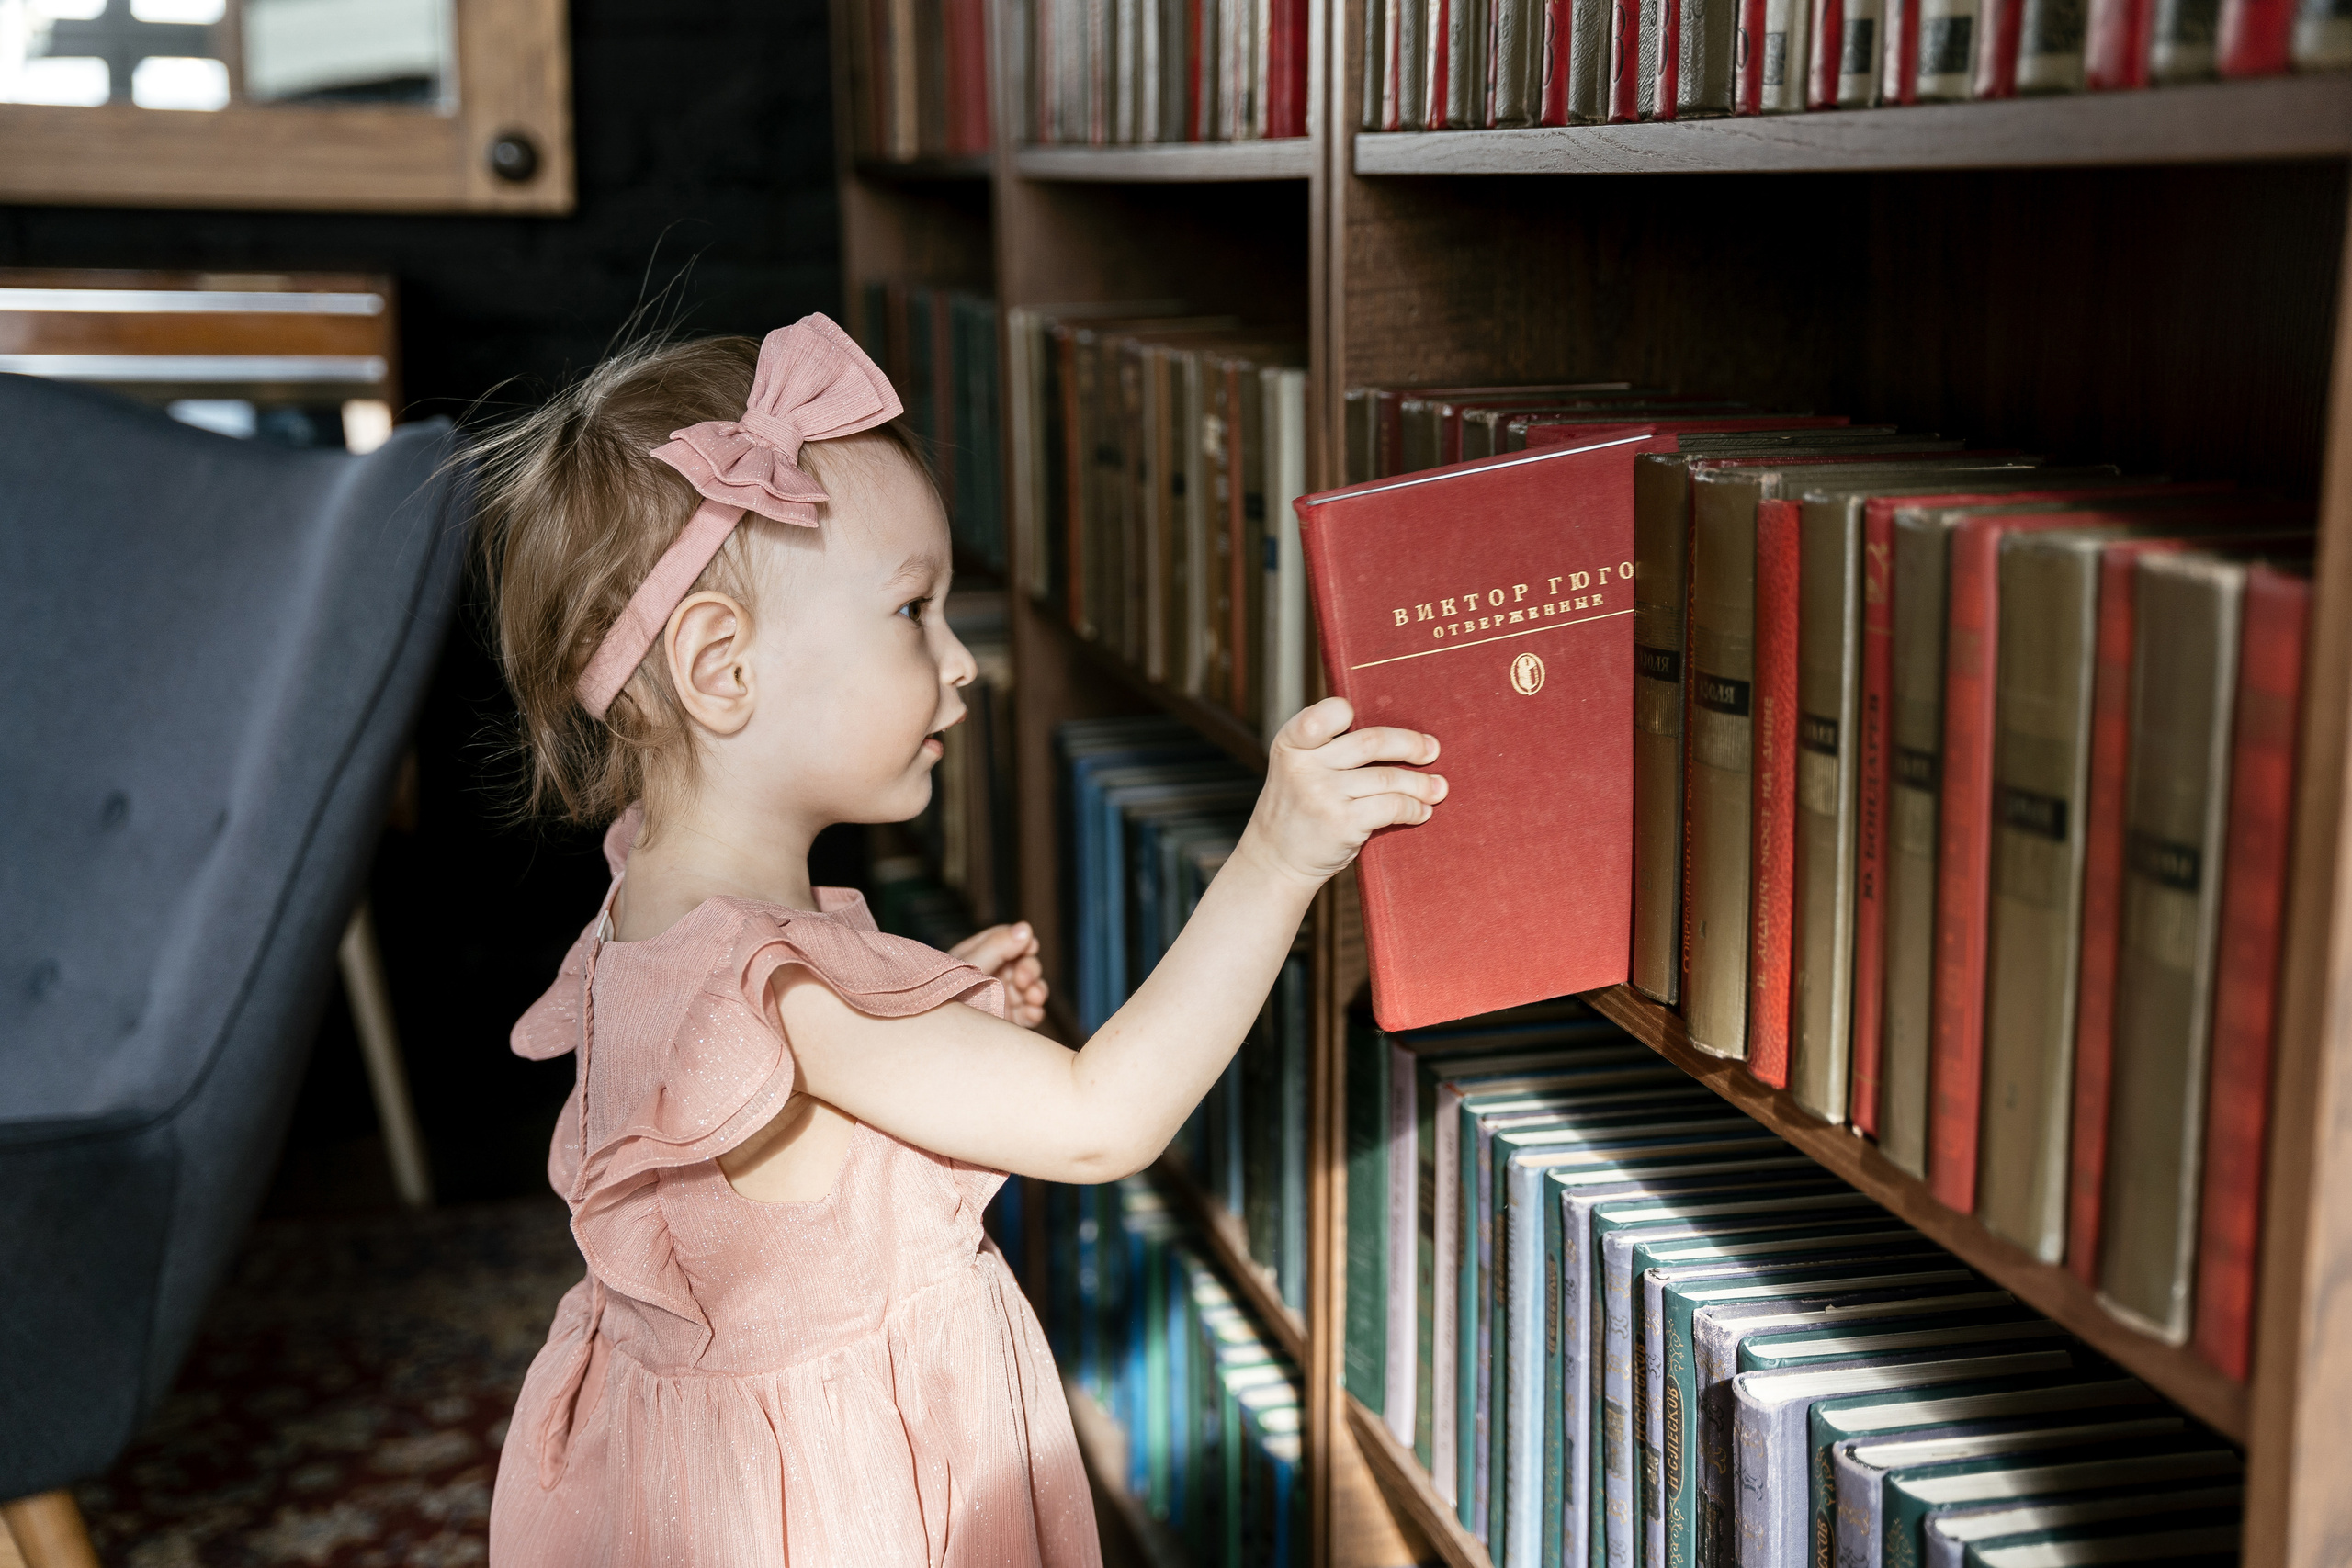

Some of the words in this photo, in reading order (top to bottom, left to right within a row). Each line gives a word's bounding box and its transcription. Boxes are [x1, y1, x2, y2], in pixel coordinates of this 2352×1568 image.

[1392, 583, 1529, 626] ВИКТОР
[1548, 561, 1634, 595] ГЮГО
[1433, 593, 1604, 638] ОТВЕРЖЕННЫЕ
